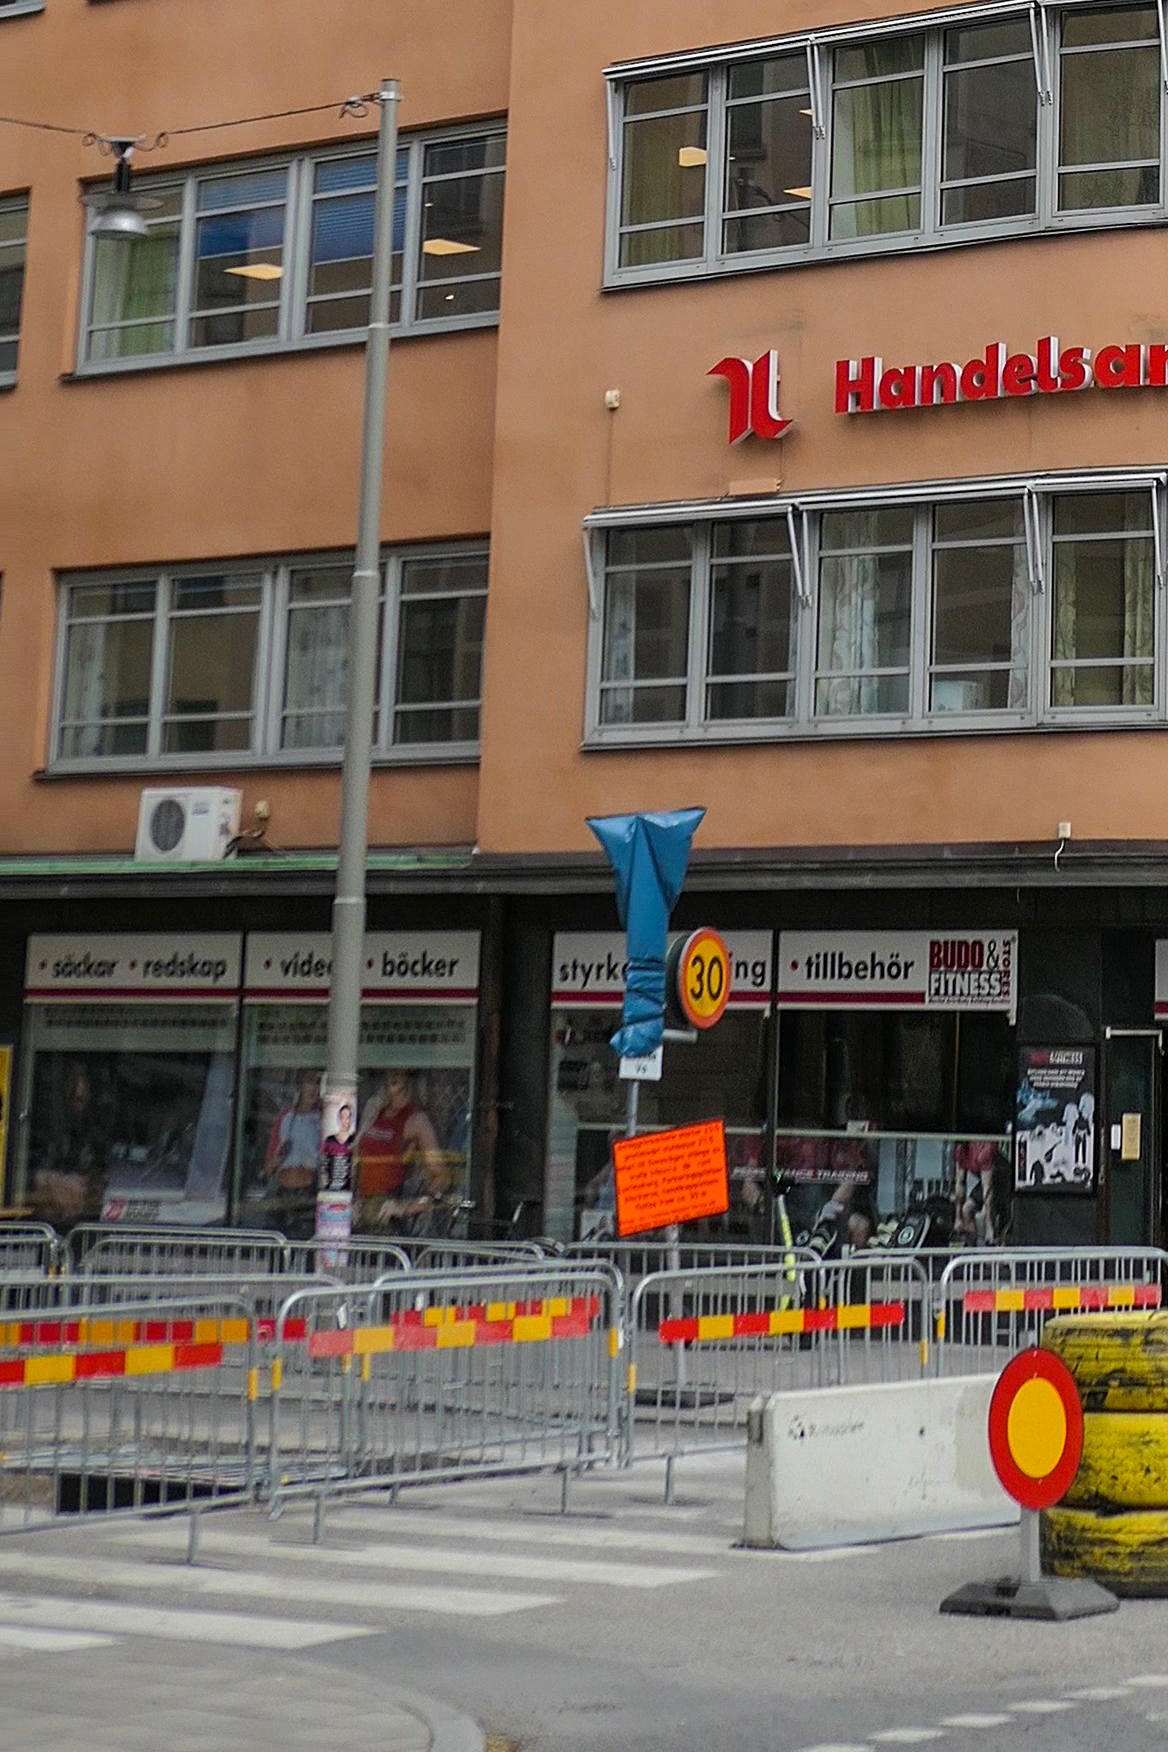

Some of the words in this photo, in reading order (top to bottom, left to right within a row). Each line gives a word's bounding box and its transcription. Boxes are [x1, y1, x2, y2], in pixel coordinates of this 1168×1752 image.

[142, 951, 228, 984] redskap
[381, 950, 460, 978] böcker
[805, 951, 915, 981] tillbehör
[929, 940, 984, 971] BUDO
[986, 939, 1000, 969] &
[690, 955, 724, 1001] 30
[929, 971, 1001, 997] FITNESS
